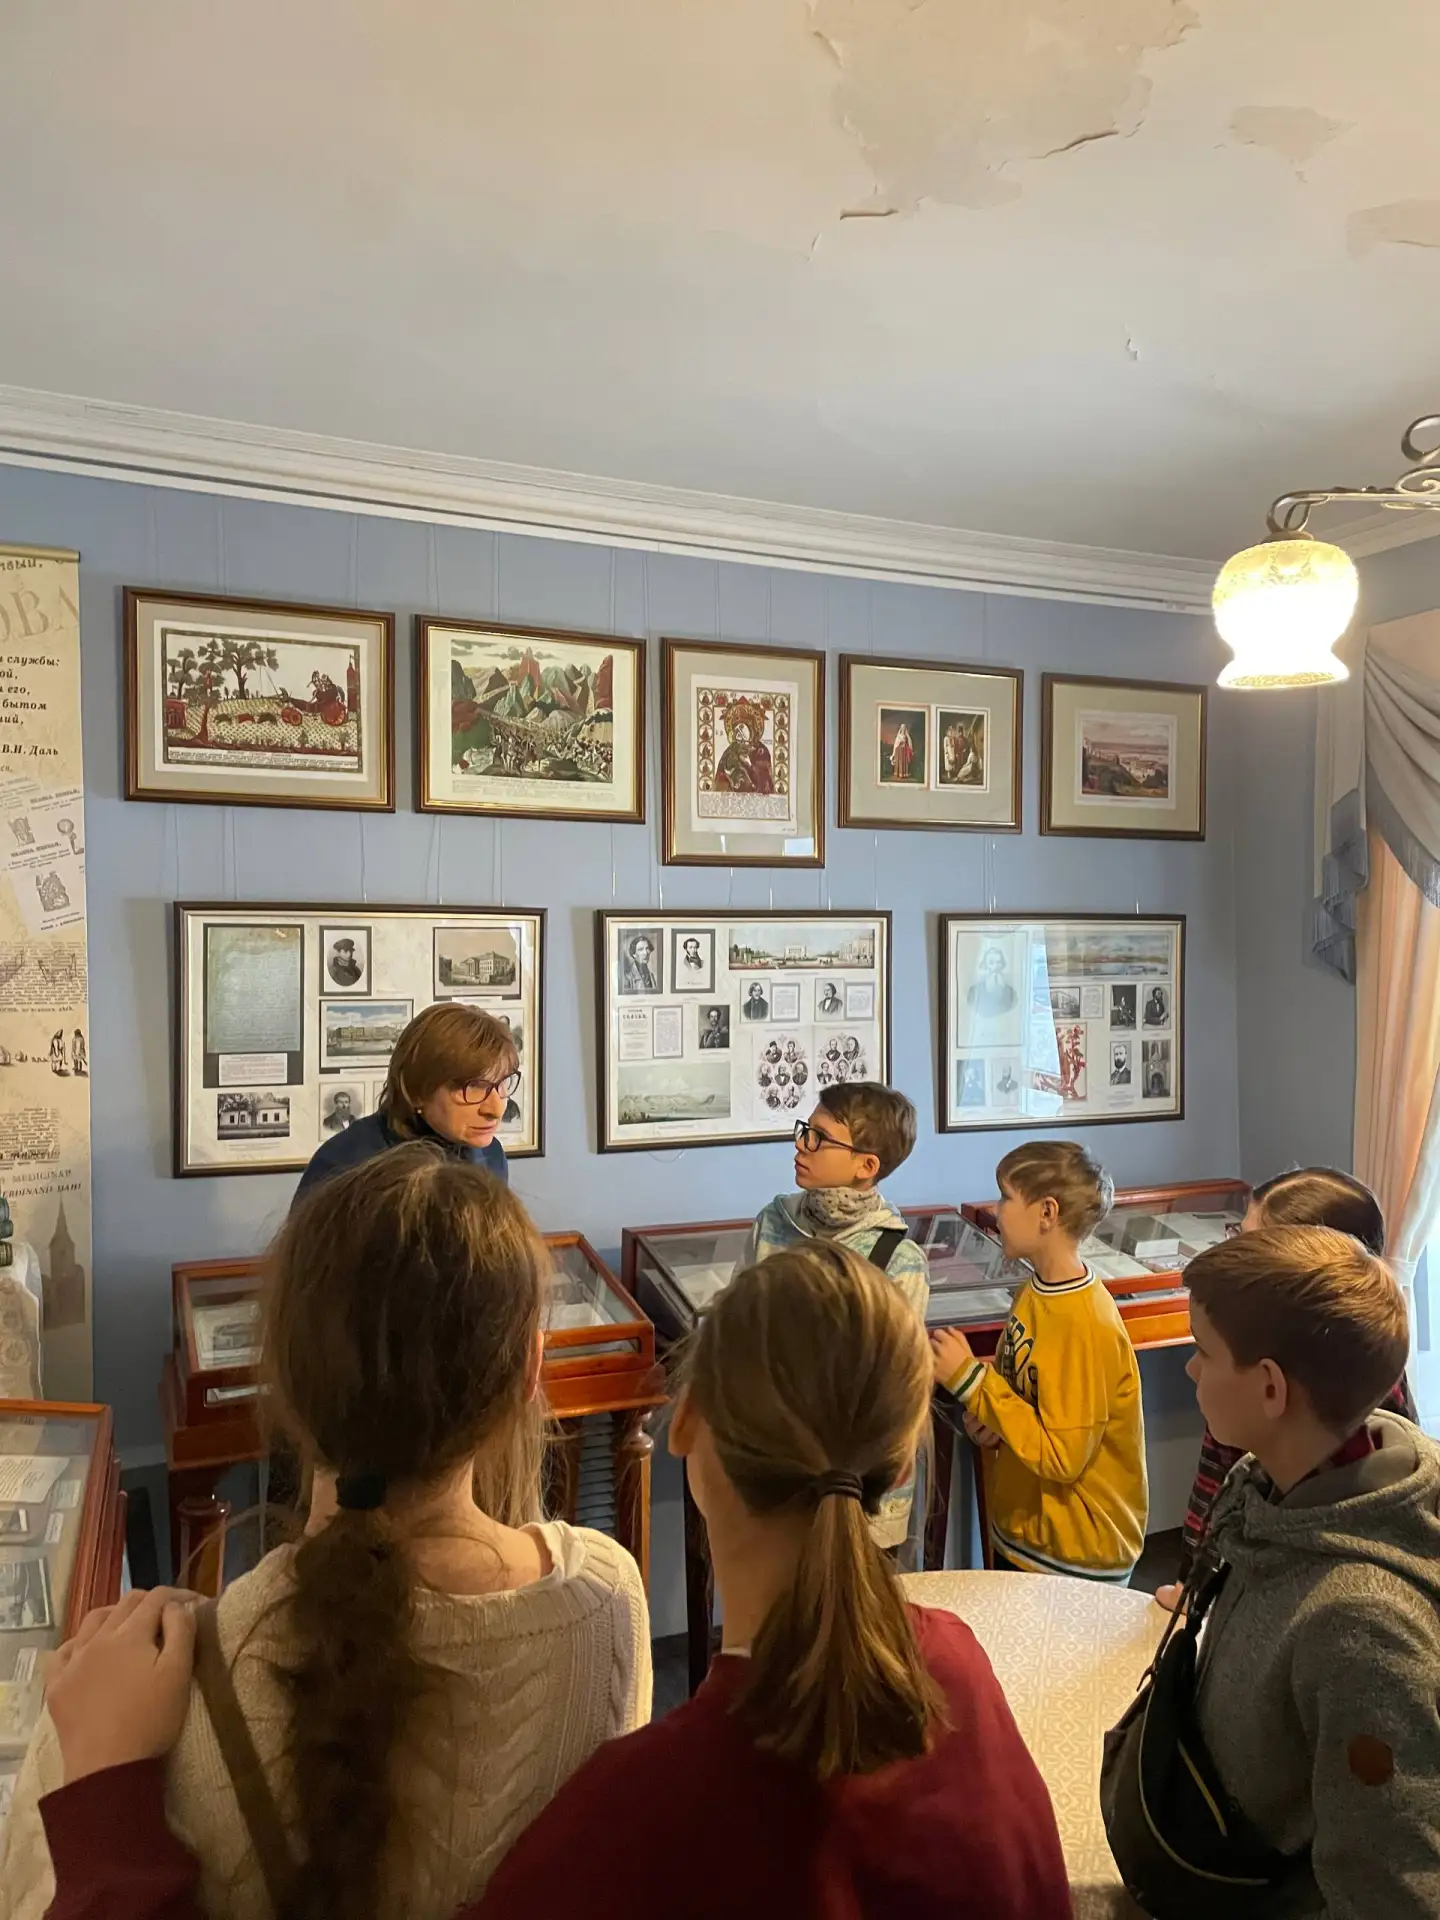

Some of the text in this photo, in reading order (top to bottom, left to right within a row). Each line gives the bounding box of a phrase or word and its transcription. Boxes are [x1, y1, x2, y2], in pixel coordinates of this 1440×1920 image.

[7, 655, 60, 667] службы:
[7, 686, 31, 696] его,
[2, 698, 47, 710] бытом
[29, 745, 59, 757] Даль
